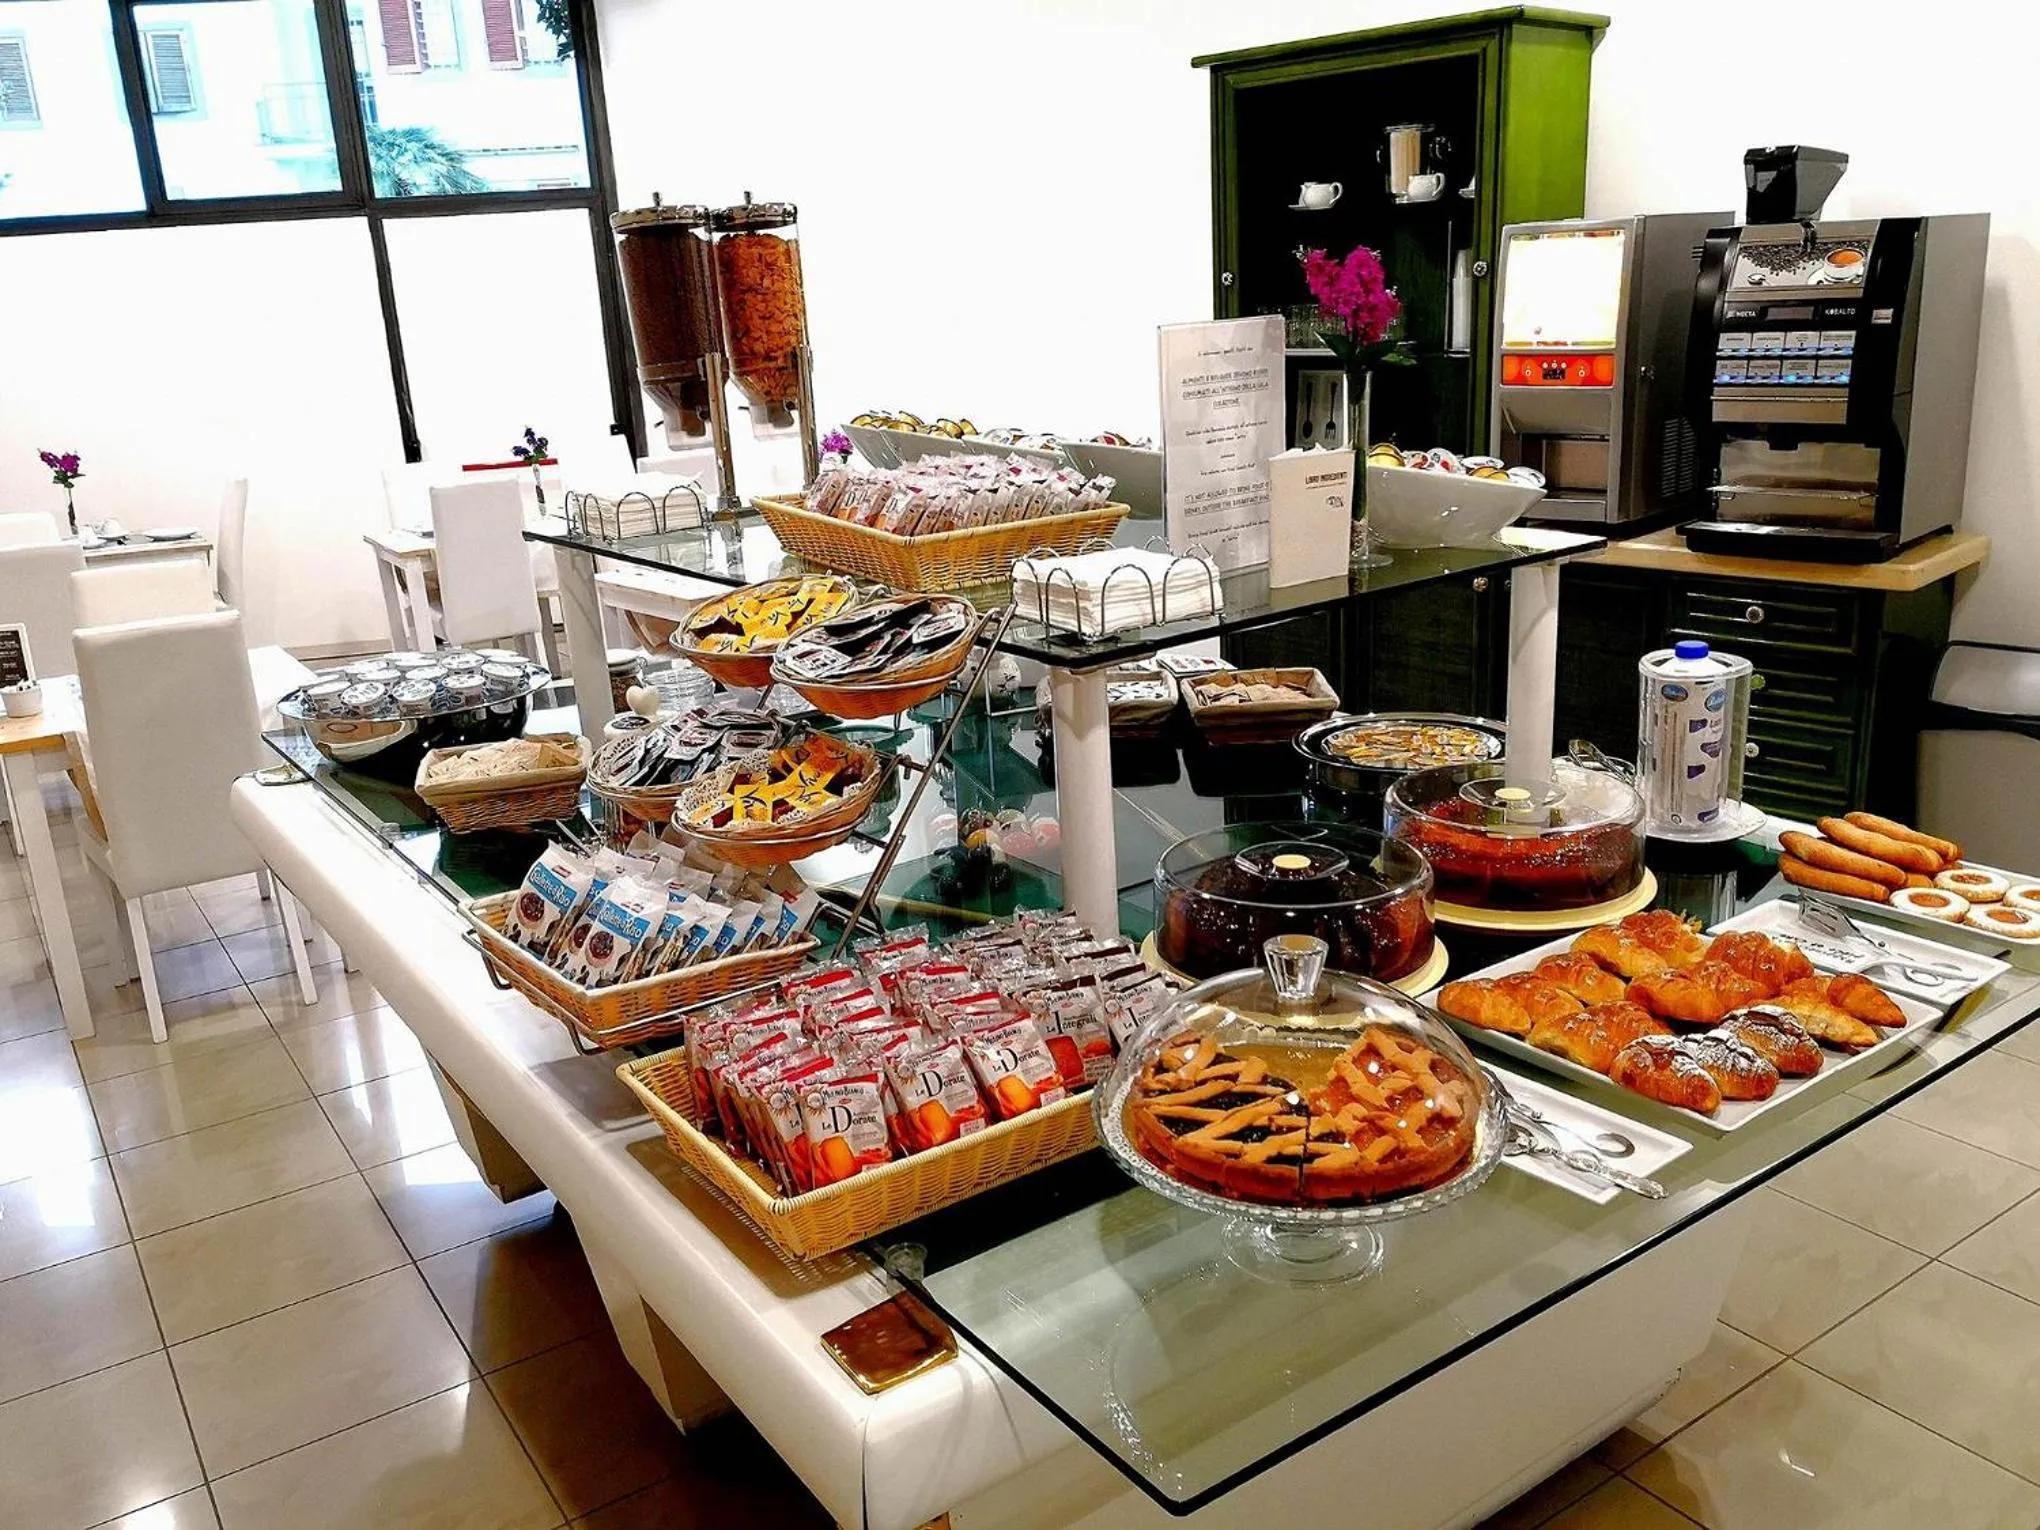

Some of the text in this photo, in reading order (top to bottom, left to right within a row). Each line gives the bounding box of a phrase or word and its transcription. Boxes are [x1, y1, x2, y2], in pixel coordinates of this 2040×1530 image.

[1825, 307, 1856, 316] KOBALTO
[1047, 1010, 1098, 1035] Le Integrali
[991, 1047, 1041, 1074] Le Dorate
[914, 1087, 925, 1097] Le
[919, 1070, 966, 1098] Dorate
[822, 1104, 878, 1134] Le Dorate
